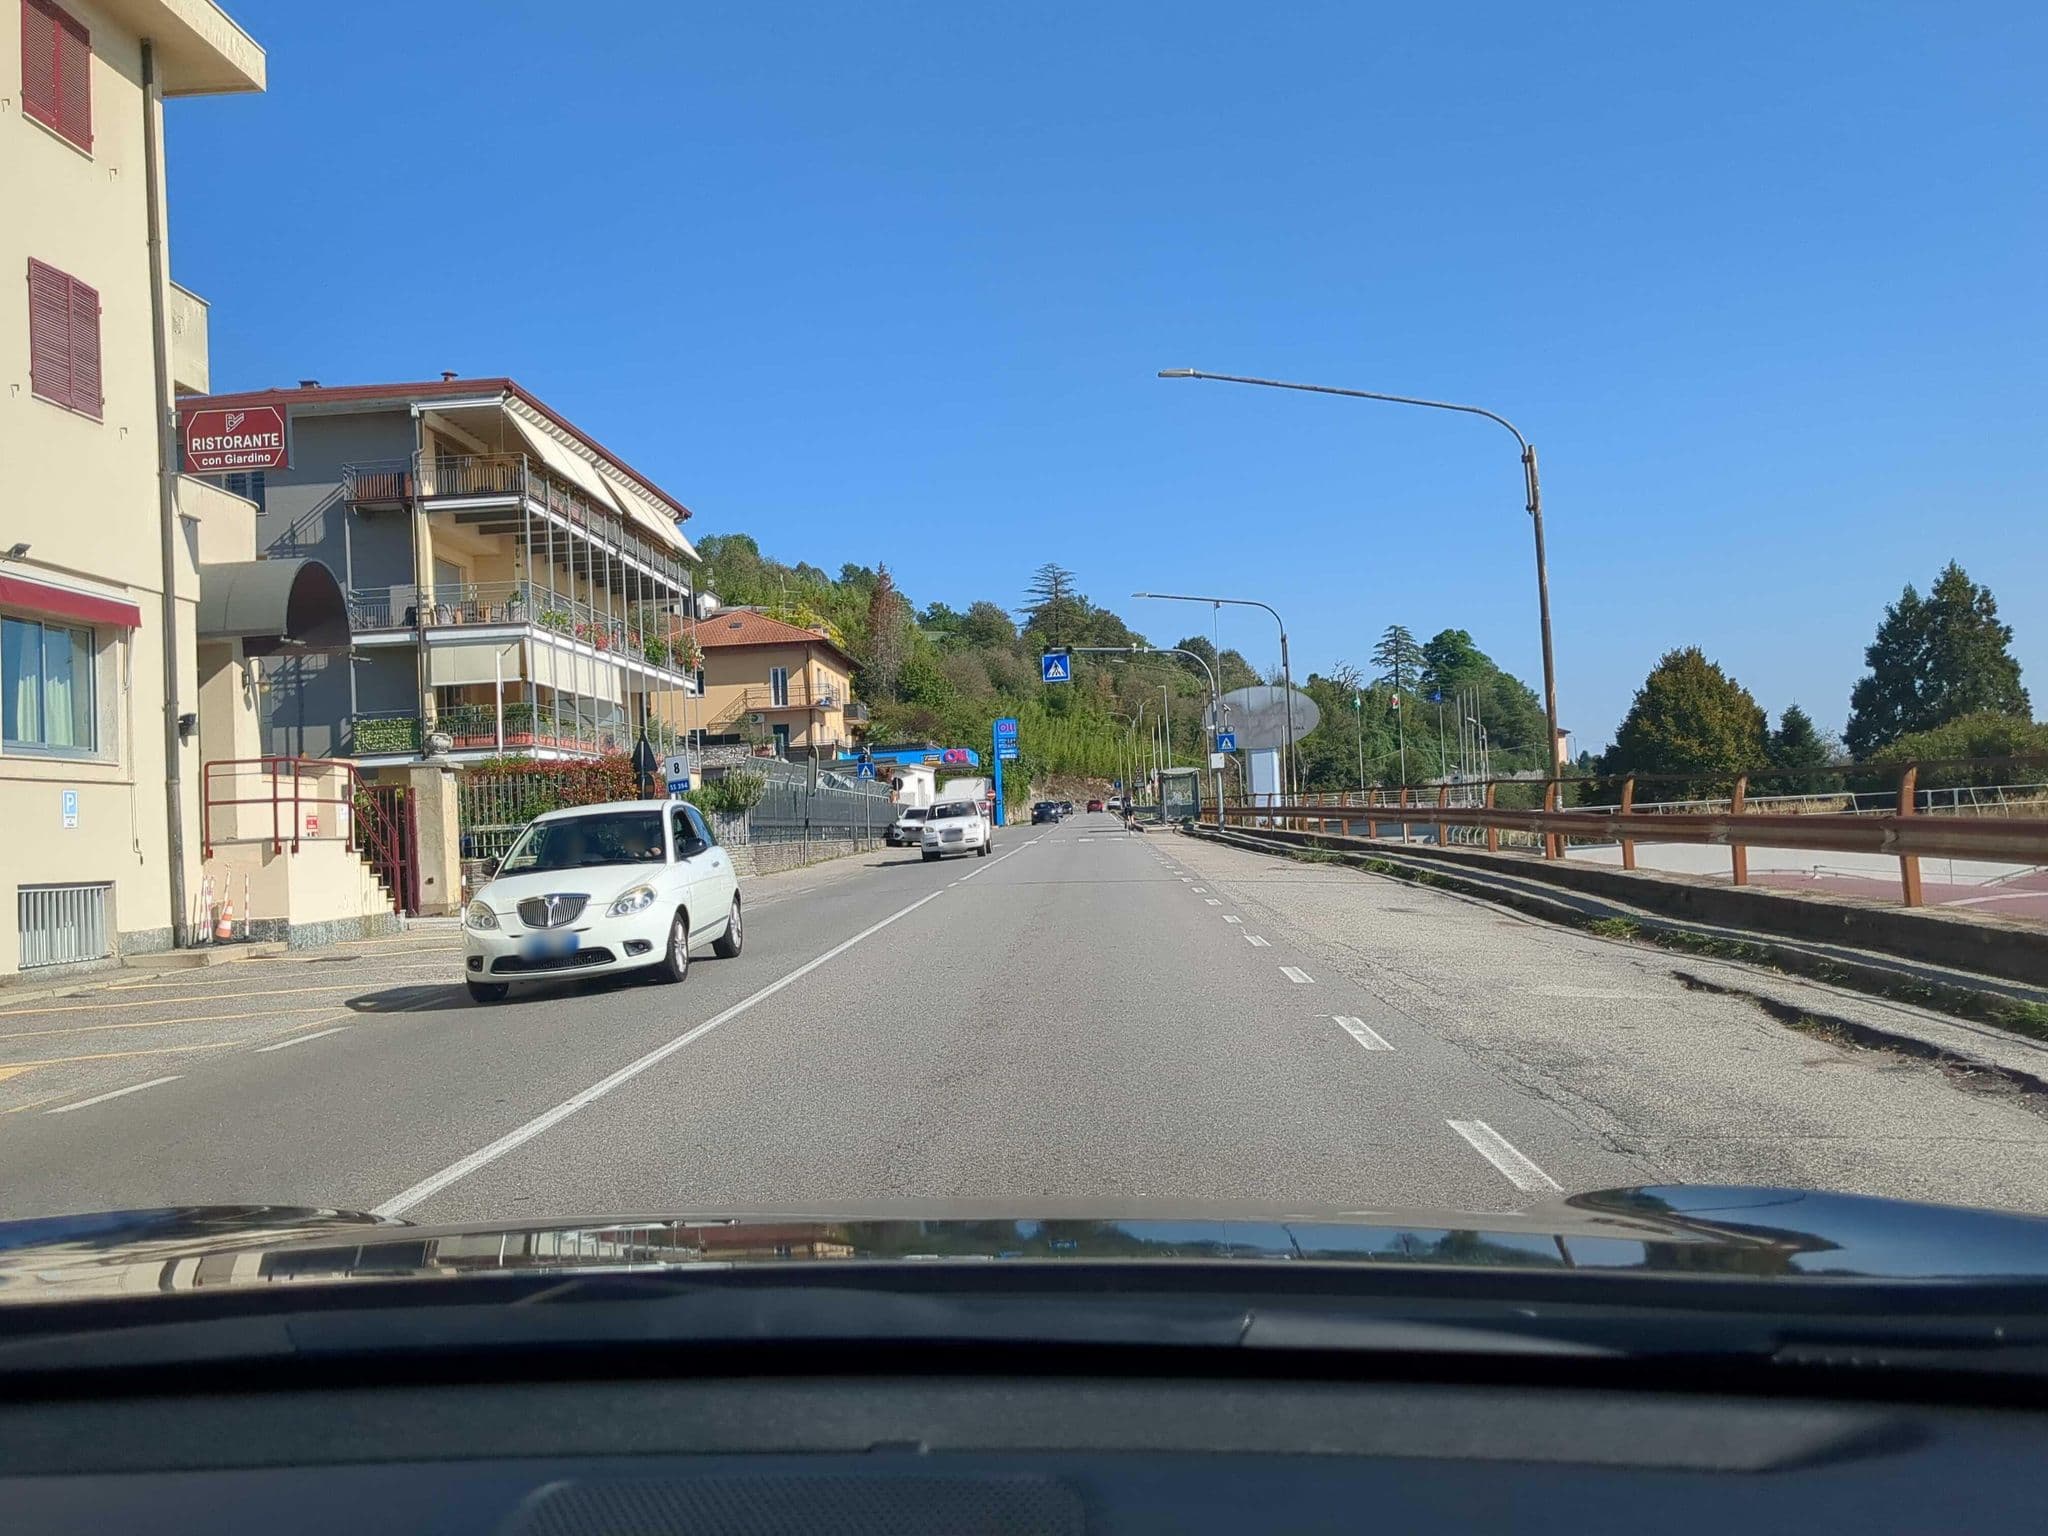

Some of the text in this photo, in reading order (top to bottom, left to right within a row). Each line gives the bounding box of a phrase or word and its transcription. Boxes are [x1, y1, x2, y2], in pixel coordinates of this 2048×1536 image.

[192, 433, 280, 451] RISTORANTE
[202, 452, 271, 465] con Giardino
[673, 762, 680, 774] 8
